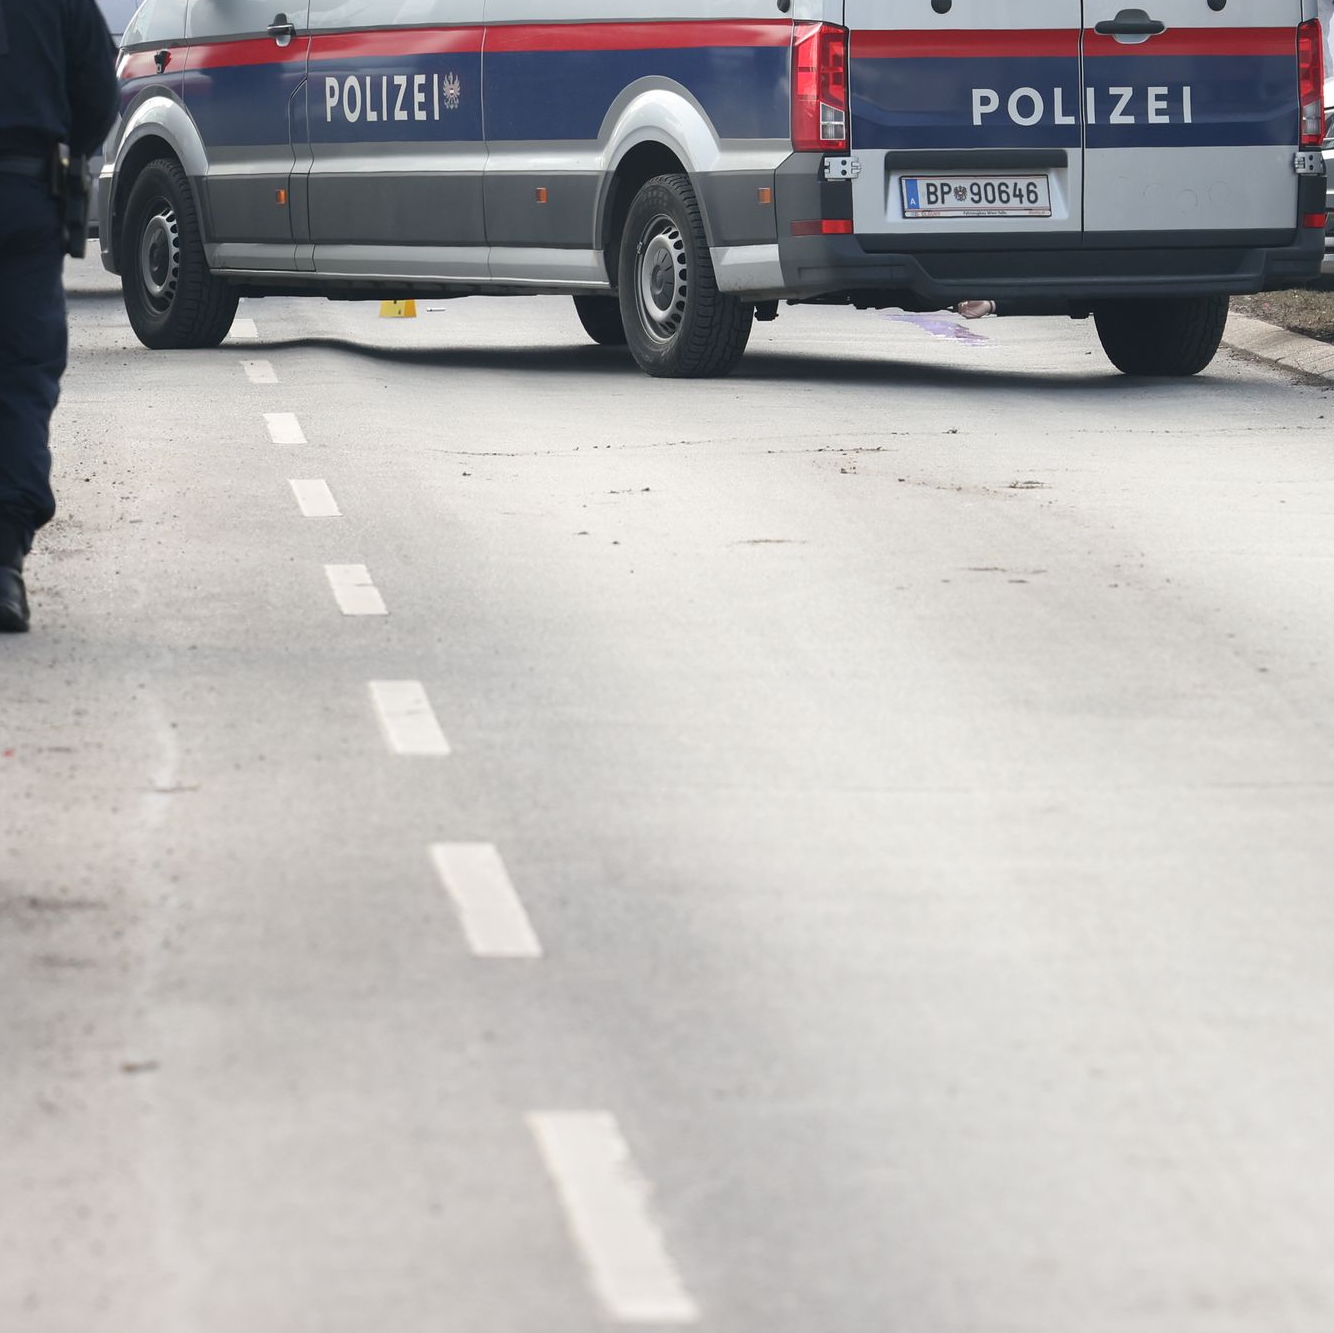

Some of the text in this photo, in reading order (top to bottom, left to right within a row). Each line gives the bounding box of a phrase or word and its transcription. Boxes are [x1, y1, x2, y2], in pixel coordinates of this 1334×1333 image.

[325, 73, 440, 123] POLIZEI
[972, 86, 1192, 126] POLIZEI
[925, 182, 1039, 205] BP 90646
